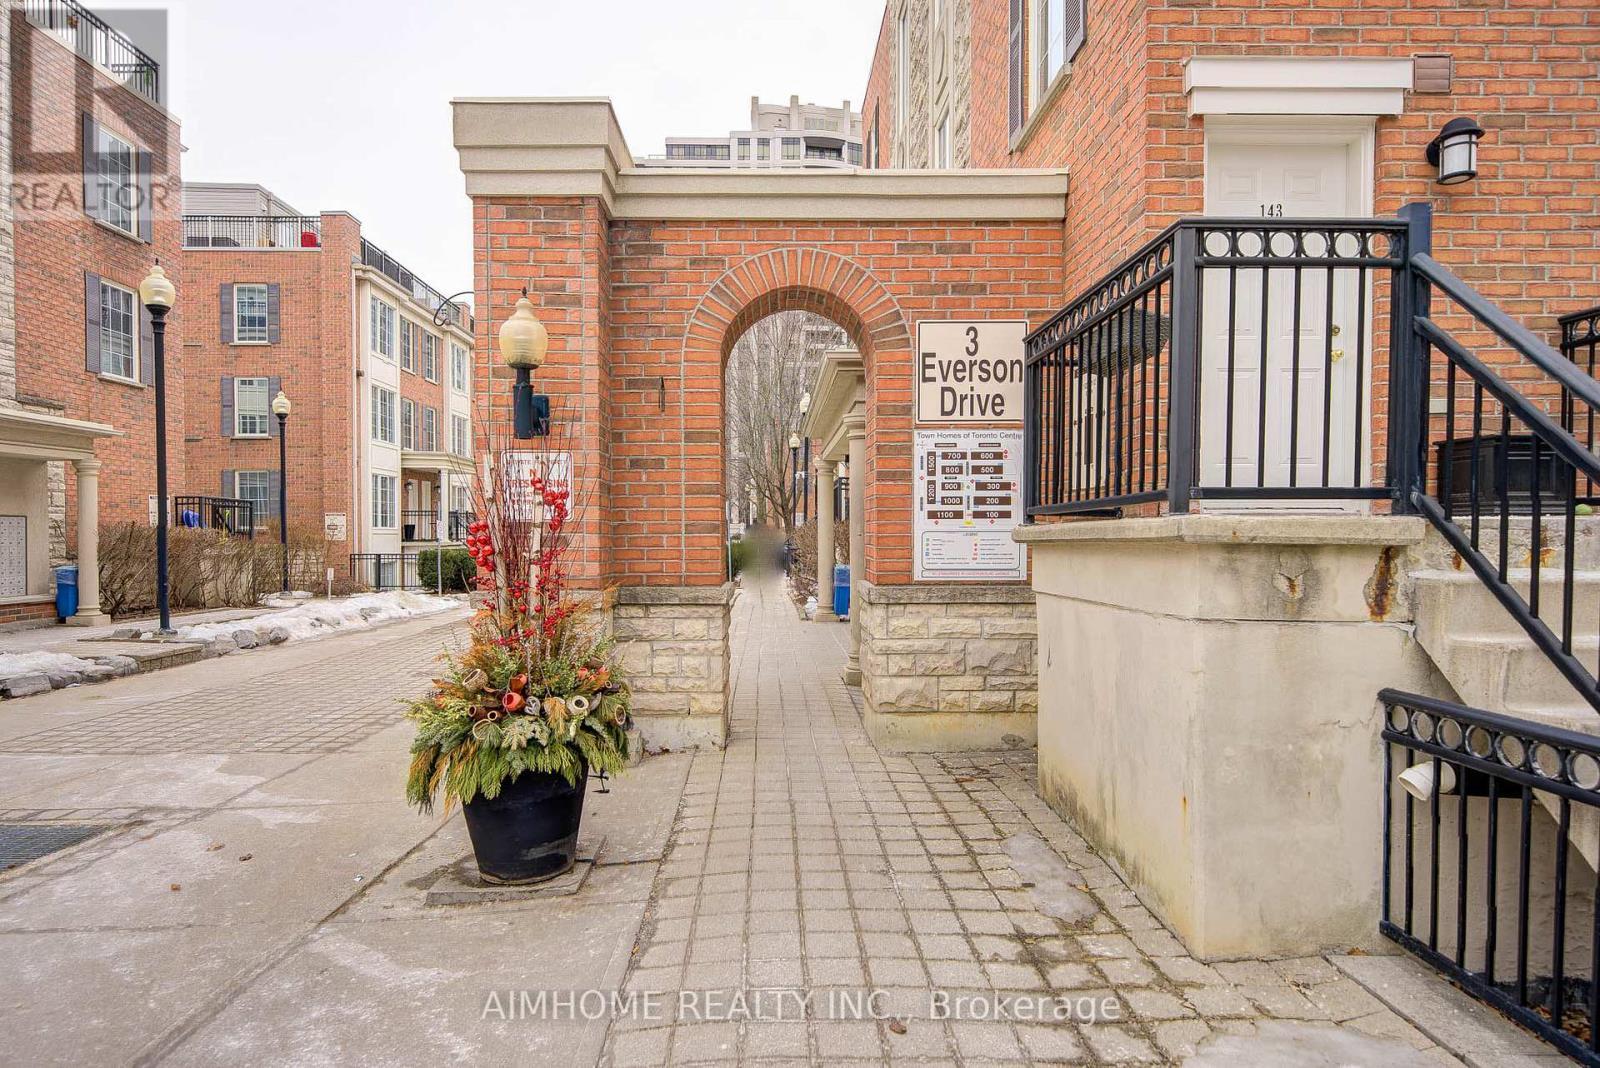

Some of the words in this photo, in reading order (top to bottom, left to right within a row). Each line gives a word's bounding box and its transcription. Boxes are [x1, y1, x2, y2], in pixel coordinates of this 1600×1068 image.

[1260, 203, 1283, 218] 143
[965, 326, 979, 357] 3
[921, 352, 1023, 384] Everson
[940, 386, 1005, 417] Drive
[947, 452, 962, 460] 700
[945, 466, 960, 474] 800
[980, 466, 994, 474] 500
[943, 497, 961, 505] 1000
[986, 497, 1000, 505] 200
[937, 511, 954, 519] 1100
[986, 511, 999, 519] 100
